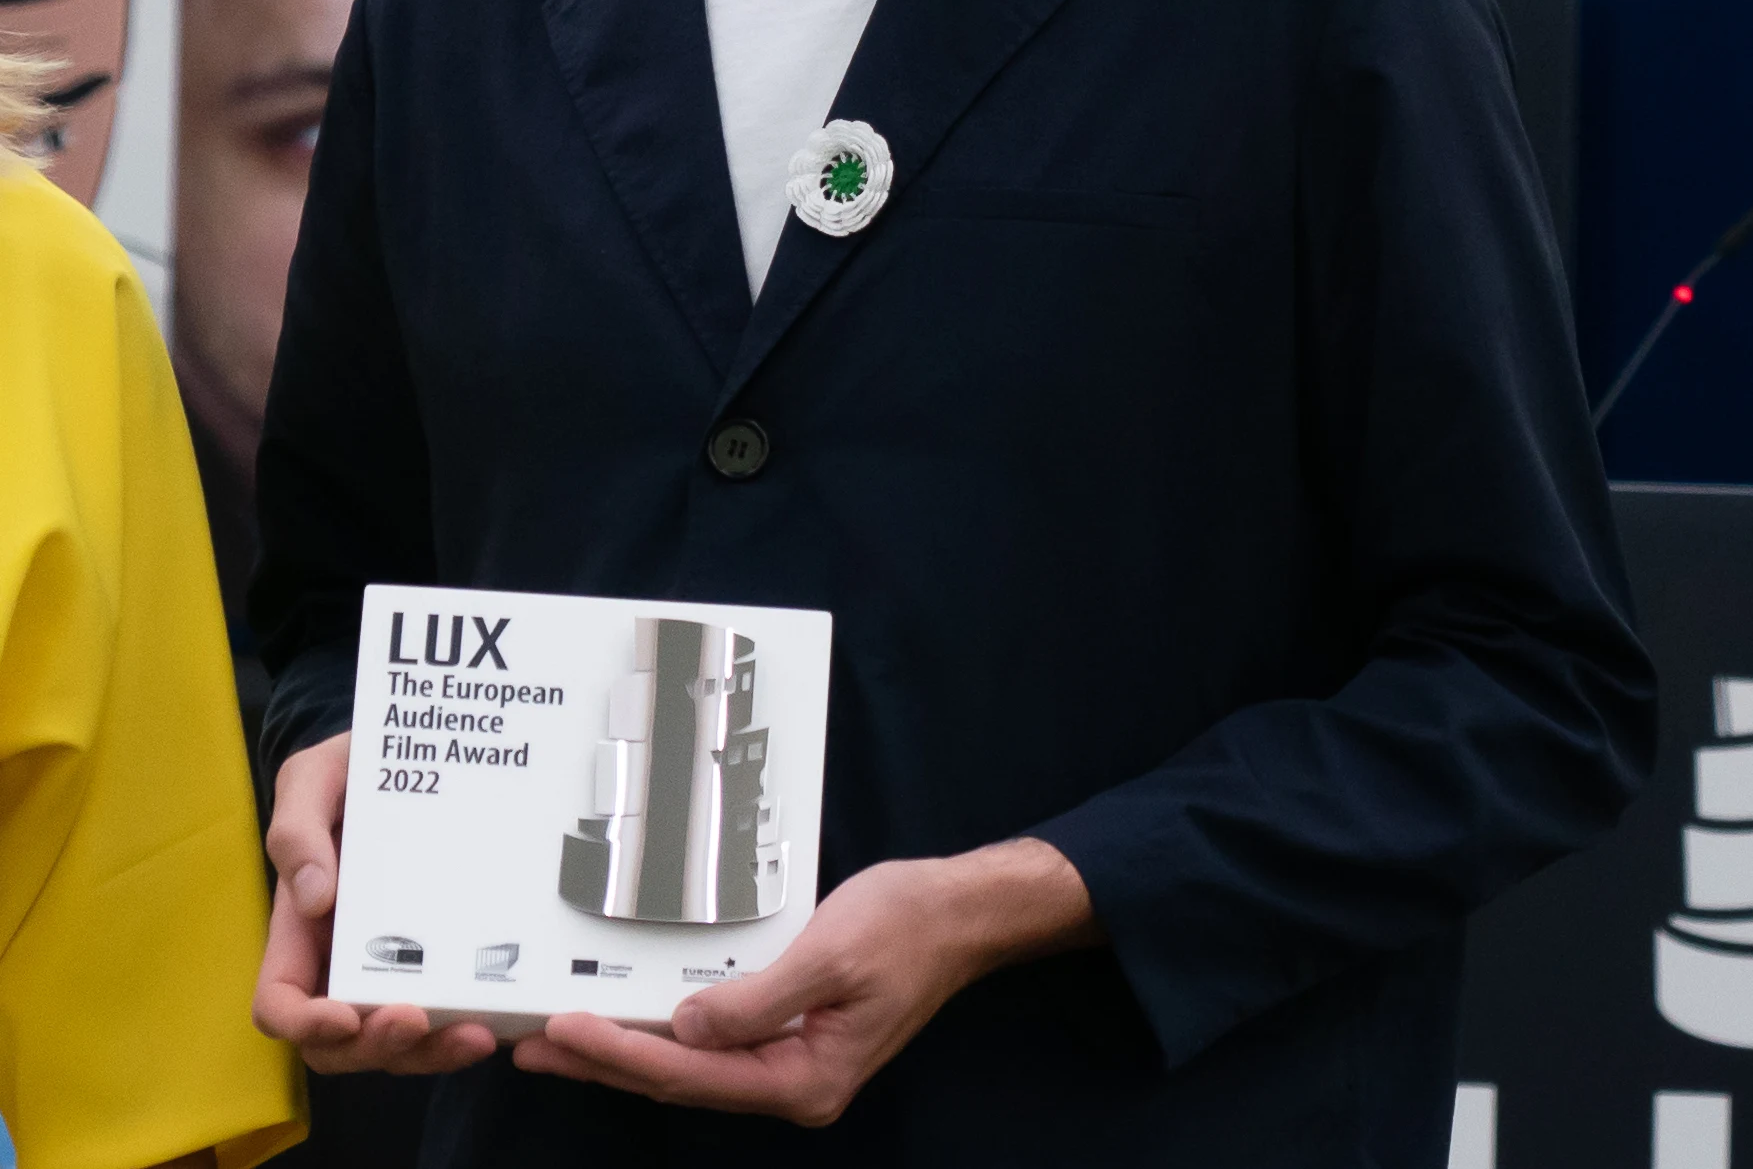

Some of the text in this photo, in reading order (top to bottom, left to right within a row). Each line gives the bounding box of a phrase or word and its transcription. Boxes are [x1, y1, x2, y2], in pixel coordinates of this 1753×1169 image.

[388, 611, 512, 671] LUX
[387, 671, 564, 708] The European
[383, 703, 504, 734] Audience
[382, 735, 529, 767] Film Award
[377, 768, 440, 794] 2022
[682, 968, 726, 977] EUROPA
